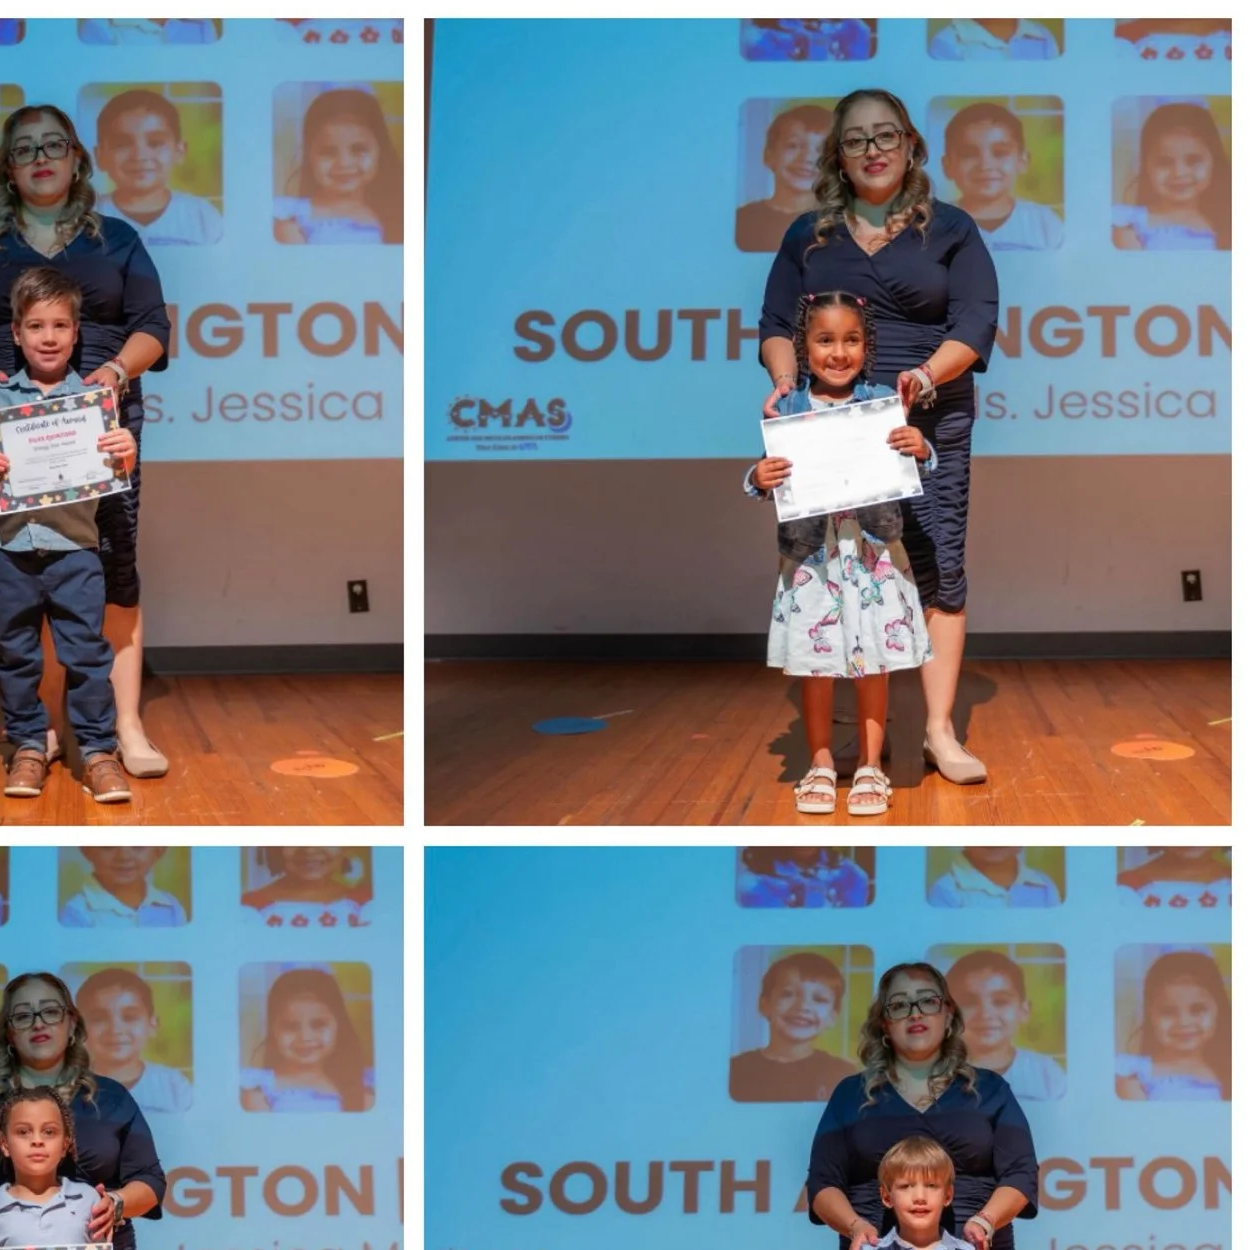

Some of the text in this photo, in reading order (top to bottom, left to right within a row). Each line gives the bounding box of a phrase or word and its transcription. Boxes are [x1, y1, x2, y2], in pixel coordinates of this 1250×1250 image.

[191, 382, 384, 424] Jessica
[448, 397, 571, 431] CMAS
[1033, 381, 1217, 420] Jessica
[500, 1160, 771, 1216] SOUTH
